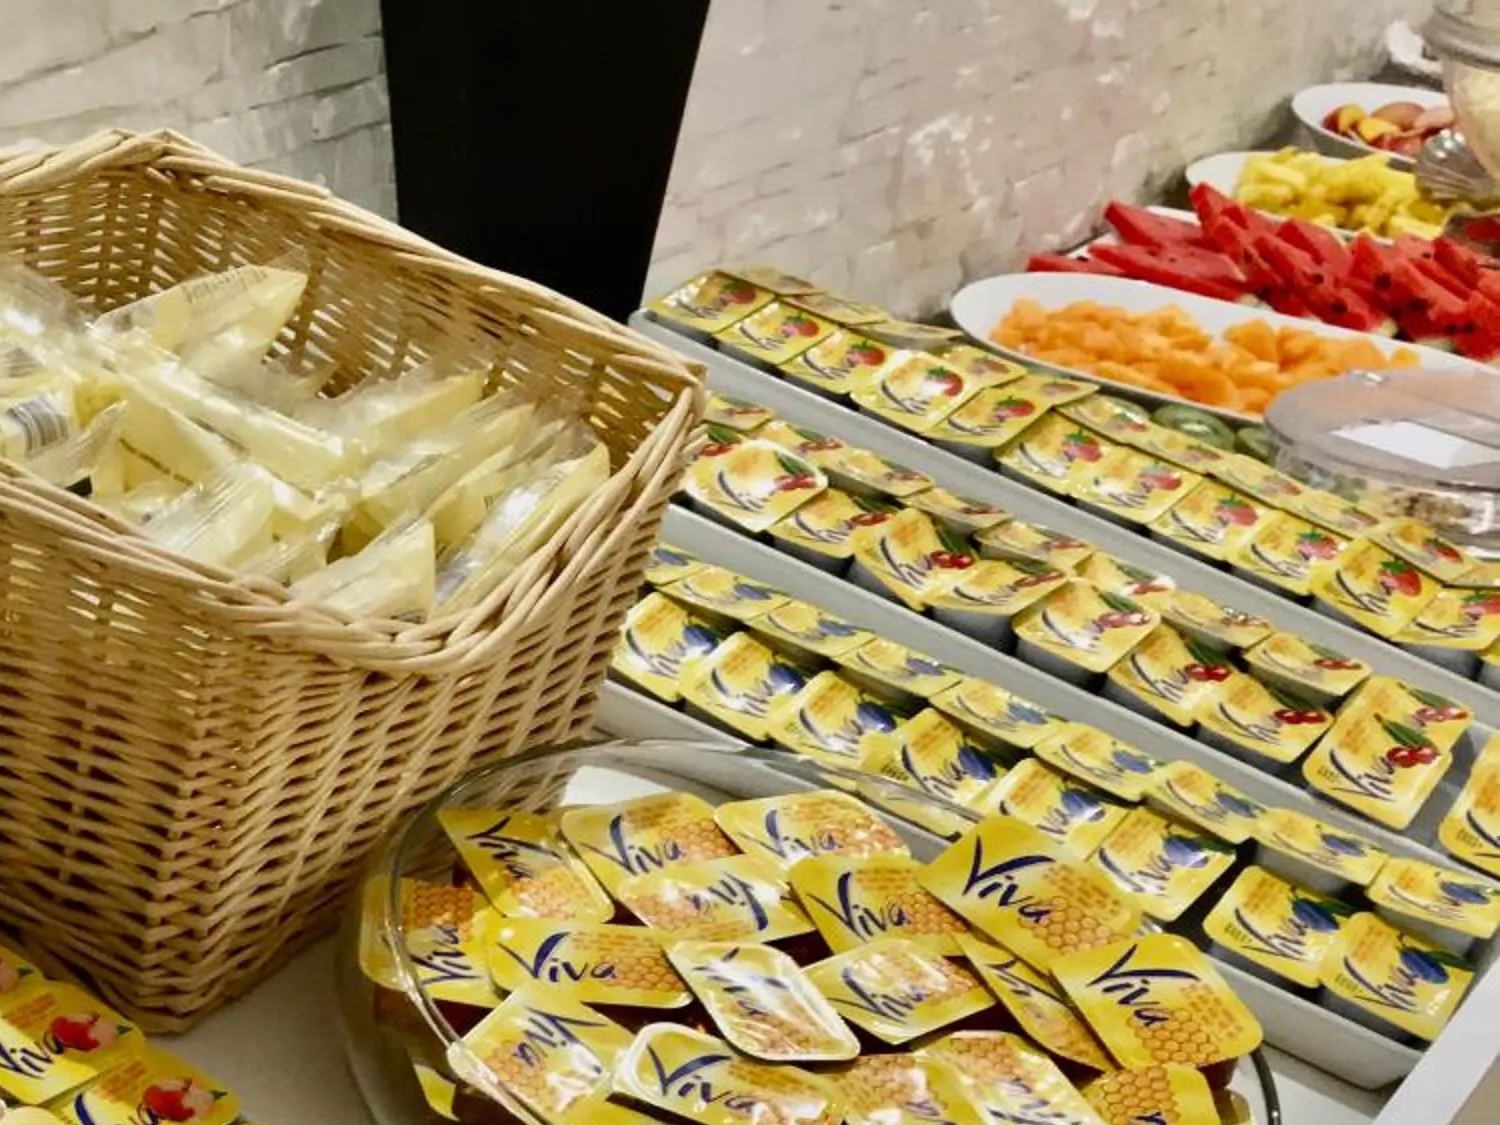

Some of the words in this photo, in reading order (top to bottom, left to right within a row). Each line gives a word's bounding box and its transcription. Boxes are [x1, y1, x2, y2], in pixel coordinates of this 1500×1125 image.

[580, 815, 686, 876] Viva
[964, 836, 1056, 923] Viva
[807, 872, 912, 942] Viva
[497, 932, 620, 981] Viva
[1087, 944, 1200, 1028] Viva
[826, 967, 926, 1024] Viva
[647, 1043, 758, 1114] Viva
